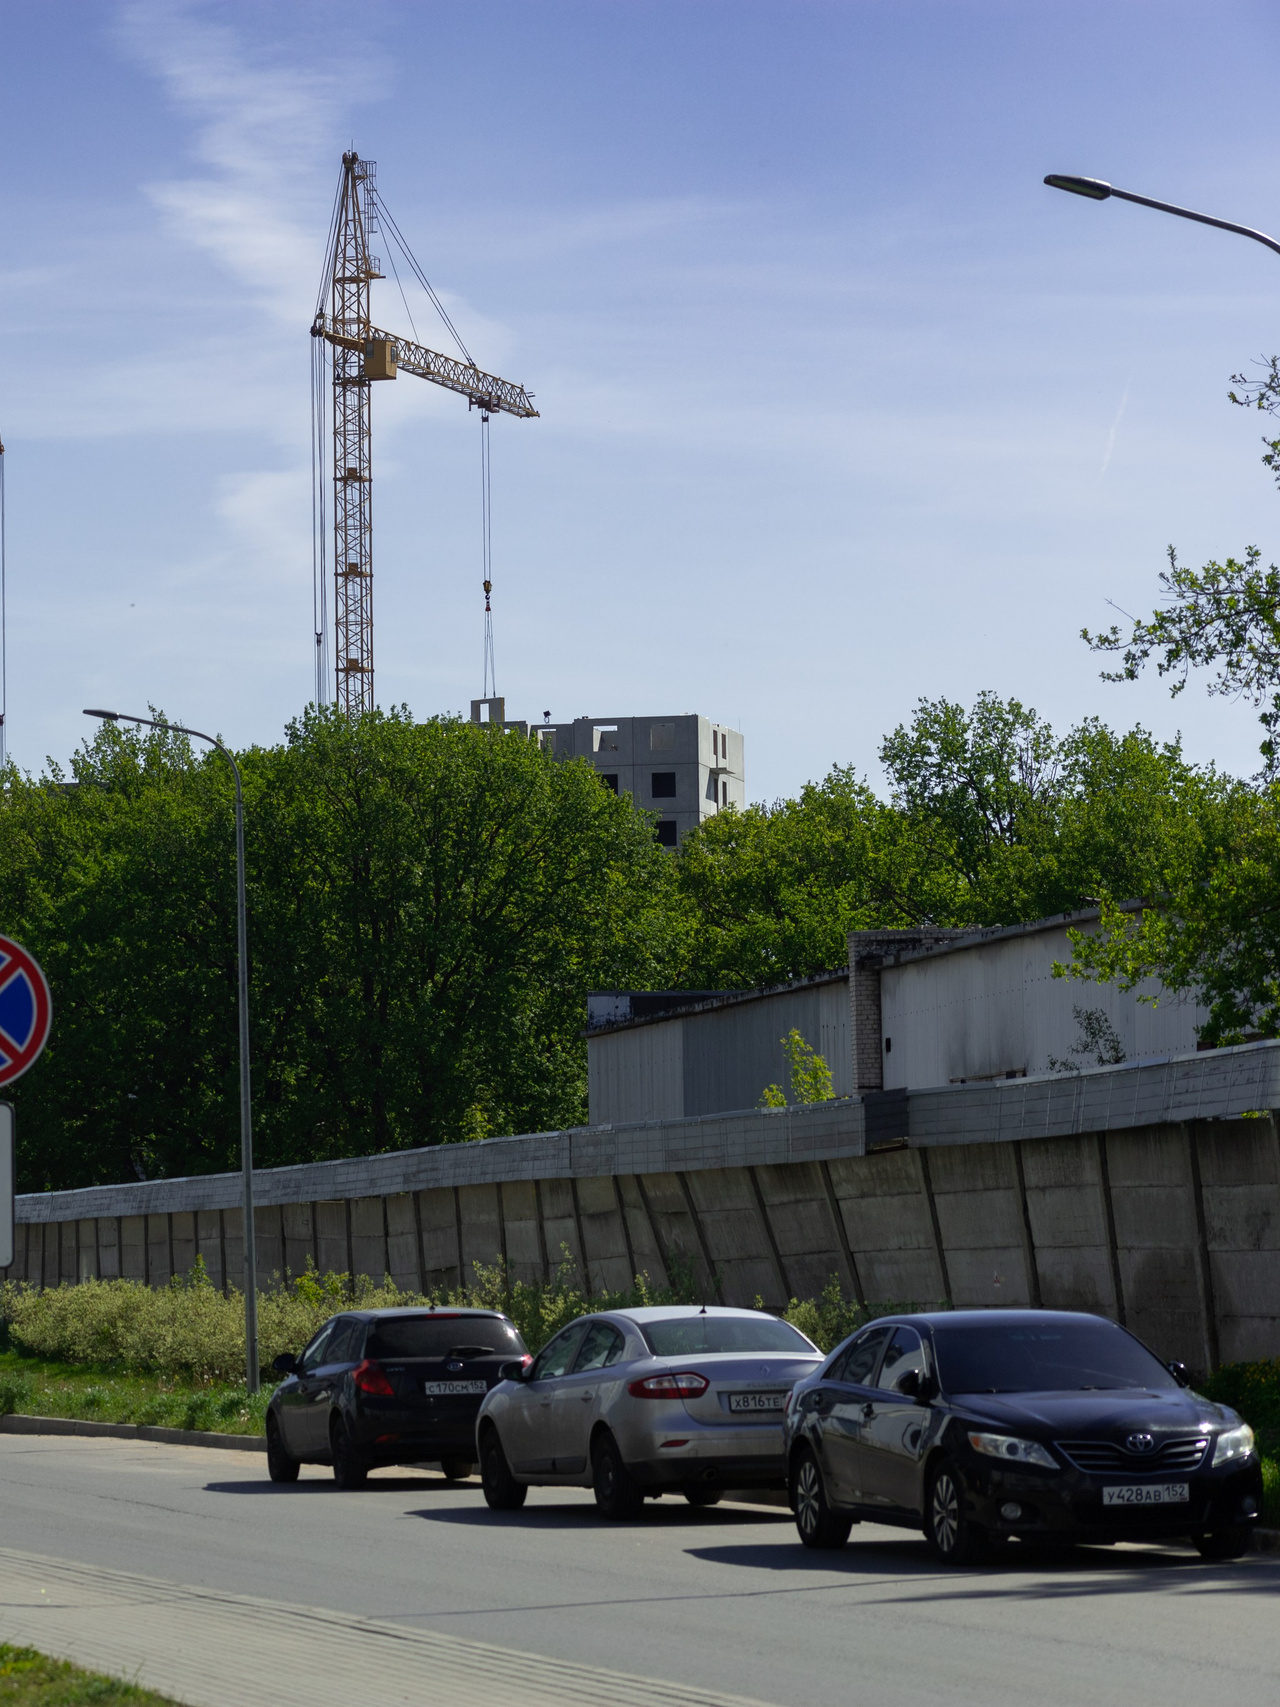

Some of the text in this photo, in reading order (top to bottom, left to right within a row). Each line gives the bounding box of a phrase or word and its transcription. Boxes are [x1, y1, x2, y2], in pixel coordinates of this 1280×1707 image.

[428, 1381, 484, 1394] С170СМ 152
[734, 1395, 781, 1408] Х816ТЕ
[1107, 1485, 1186, 1503] У428АВ 152
